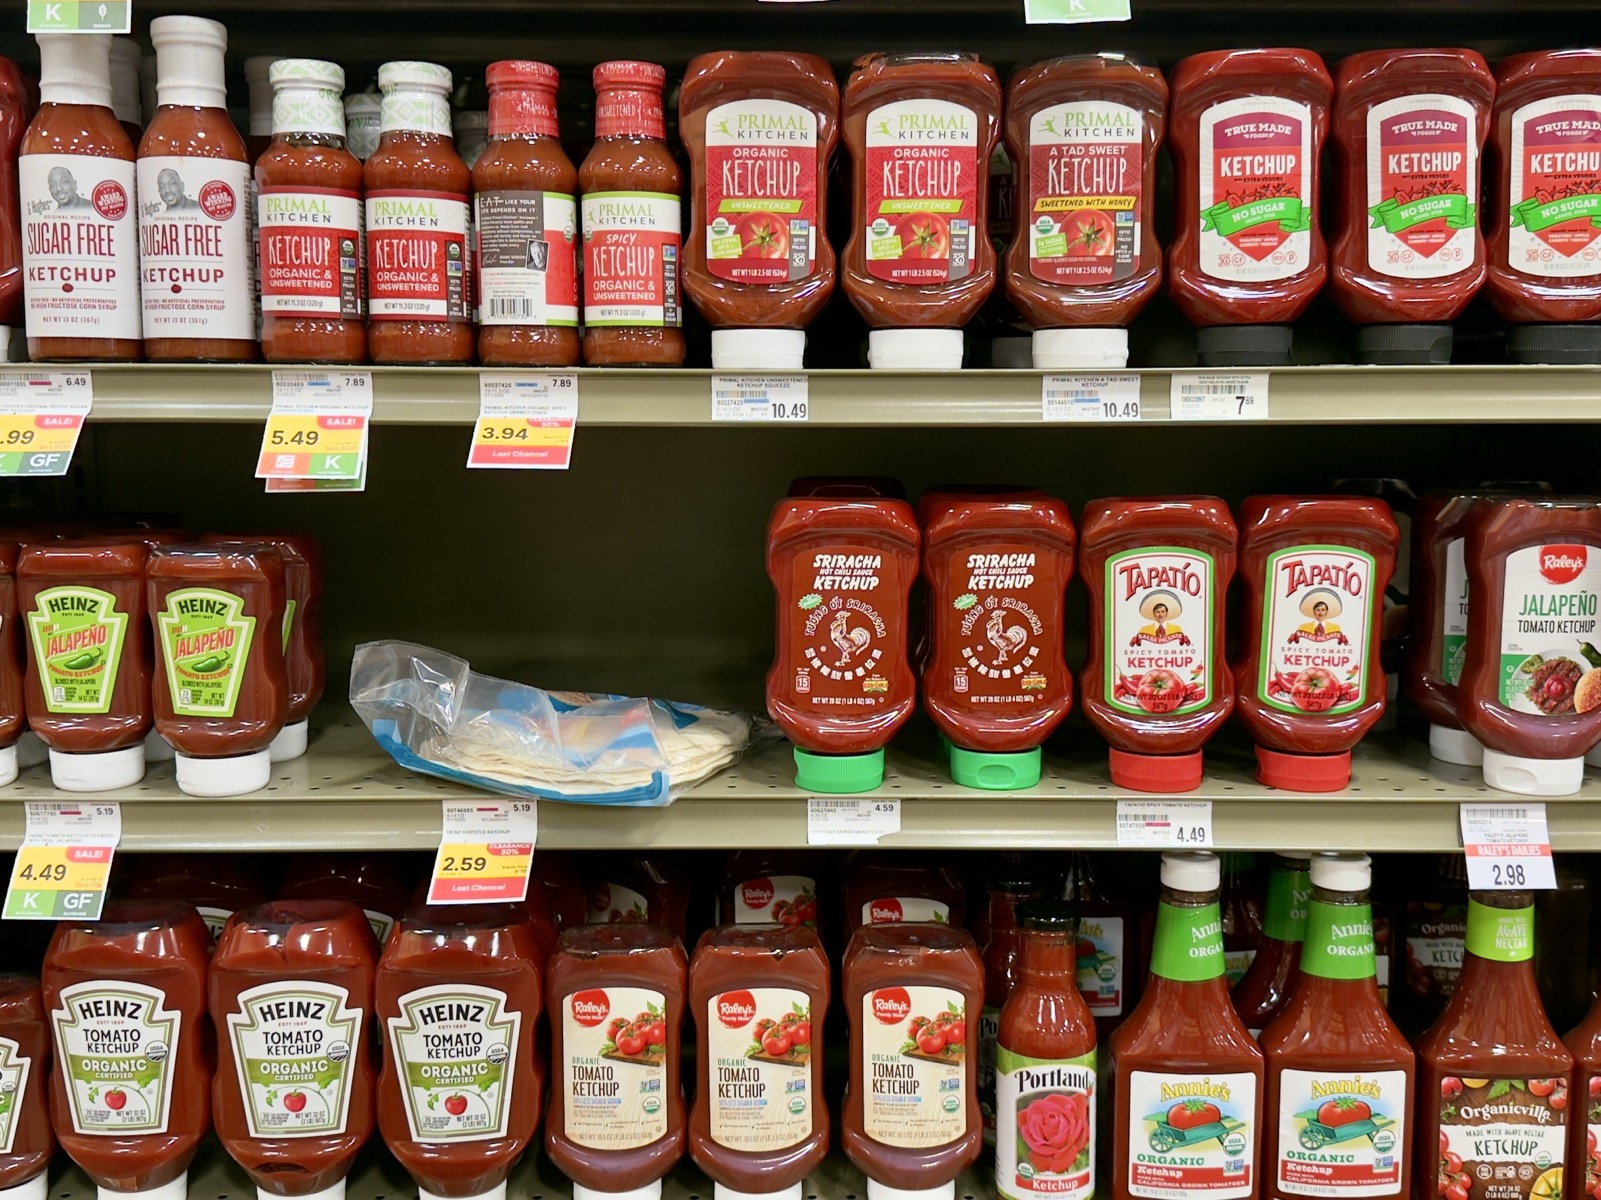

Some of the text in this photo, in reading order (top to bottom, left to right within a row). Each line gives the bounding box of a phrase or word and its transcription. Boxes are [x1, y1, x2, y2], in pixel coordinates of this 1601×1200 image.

[738, 114, 808, 130] PRIMAL
[898, 114, 968, 130] PRIMAL
[1064, 112, 1134, 127] PRIMAL
[1064, 128, 1134, 137] KITCHEN
[1224, 122, 1292, 138] TRUE MADE
[1392, 120, 1458, 134] TRUE MADE
[738, 130, 808, 140] KITCHEN
[898, 130, 969, 140] KITCHEN
[733, 148, 788, 158] ORGANIC
[894, 148, 949, 158] ORGANIC
[1050, 146, 1125, 155] A TAD SWEET
[1220, 154, 1296, 177] KETCHUP
[1388, 152, 1462, 174] KETCHUP
[722, 160, 800, 198] KETCHUP
[883, 160, 961, 198] KETCHUP
[1048, 157, 1127, 194] KETCHUP
[267, 198, 329, 214] PRIMAL
[375, 201, 437, 217] PRIMAL
[731, 201, 790, 210] UNSWEETENED
[1040, 198, 1132, 208] SWEETENED WITH HONEY
[1400, 199, 1451, 220] NO SUGAR
[599, 204, 654, 217] PRIMAL
[1232, 201, 1285, 222] NO SUGAR
[267, 213, 331, 224] KITCHEN
[375, 217, 439, 228] KITCHEN
[599, 217, 656, 225] KITCHEN
[27, 223, 115, 256] SUGAR FREE
[142, 224, 223, 257] SUGAR FREE
[607, 233, 637, 245] SPICY
[268, 235, 331, 265] KETCHUP
[376, 239, 439, 269] KETCHUP
[594, 246, 655, 277] KETCHUP
[29, 266, 116, 283] KETCHUP
[143, 267, 224, 283] KETCHUP
[270, 268, 332, 279] ORGANIC &
[378, 272, 440, 282] ORGANIC &
[270, 280, 332, 289] UNSWEETENED
[378, 284, 440, 293] UNSWEETENED
[593, 280, 655, 291] ORGANIC &
[594, 292, 655, 300] UNSWEETENED
[66, 378, 86, 386] 6.49
[345, 379, 365, 387] 7.89
[552, 379, 572, 388] 7.89
[772, 403, 806, 418] 10.49
[1103, 403, 1138, 417] 10.49
[326, 418, 356, 426] SALE!
[271, 431, 319, 445] 5.49
[482, 427, 528, 440] 3.94
[30, 454, 59, 467] GF
[325, 456, 340, 469] K
[813, 554, 881, 568] SRIRACHA
[968, 554, 1035, 568] SRIRACHA
[1544, 555, 1583, 570] Raley's
[813, 576, 879, 590] KETCHUP
[968, 576, 1034, 590] KETCHUP
[1120, 562, 1200, 600] TAPATÍO
[1282, 562, 1362, 600] TAPATÍO
[48, 597, 99, 614] HEINZ
[178, 599, 228, 616] HEINZ
[1519, 591, 1597, 616] JALAPEÑO
[1518, 620, 1595, 633] TOMATO KETCHUP
[46, 625, 107, 659] JALAPEÑO
[174, 627, 234, 661] JALAPEÑO
[1127, 657, 1193, 668] KETCHUP
[1284, 654, 1350, 666] KETCHUP
[514, 804, 530, 812] 5.19
[1177, 827, 1204, 843] 4.49
[74, 850, 103, 858] SALE!
[1478, 845, 1541, 855] RALEY'S DAILIES
[443, 857, 486, 871] 2.59
[20, 864, 67, 881] 4.49
[1493, 865, 1525, 885] 2.98
[23, 892, 40, 909] K
[63, 893, 93, 909] GF
[1496, 925, 1527, 937] AGAVE
[1496, 937, 1527, 948] NECTAR
[79, 1000, 142, 1020] HEINZ
[259, 1002, 325, 1022] HEINZ
[575, 1002, 606, 1016] Raley's
[721, 1003, 753, 1017] Raley's
[875, 998, 908, 1013] Raley's
[419, 1004, 484, 1025] HEINZ
[83, 1028, 141, 1043] TOMATO
[263, 1030, 323, 1045] TOMATO
[423, 1033, 482, 1047] TOMATO
[87, 1043, 139, 1054] KETCHUP
[266, 1044, 321, 1056] KETCHUP
[427, 1046, 480, 1059] KETCHUP
[82, 1059, 147, 1072] ORGANIC
[260, 1060, 328, 1074] ORGANIC
[420, 1064, 488, 1078] ORGANIC
[872, 1063, 914, 1078] TOMATO
[572, 1066, 613, 1081] TOMATO
[718, 1067, 759, 1082] TOMATO
[1015, 1068, 1089, 1092] Portland
[572, 1082, 619, 1097] KETCHUP
[718, 1083, 765, 1098] KETCHUP
[872, 1080, 919, 1095] KETCHUP
[1160, 1078, 1230, 1102] Annie's
[1311, 1076, 1381, 1099] Annie's
[1460, 1103, 1550, 1123] Organicville
[1475, 1139, 1538, 1156] KETCHUP
[1137, 1154, 1204, 1165] ORGANIC
[1286, 1150, 1354, 1163] ORGANIC
[1137, 1165, 1182, 1177] Ketchup
[1287, 1162, 1332, 1175] Ketchup
[1033, 1178, 1078, 1192] Ketchup
[1137, 1179, 1180, 1187] CALIFORNIA
